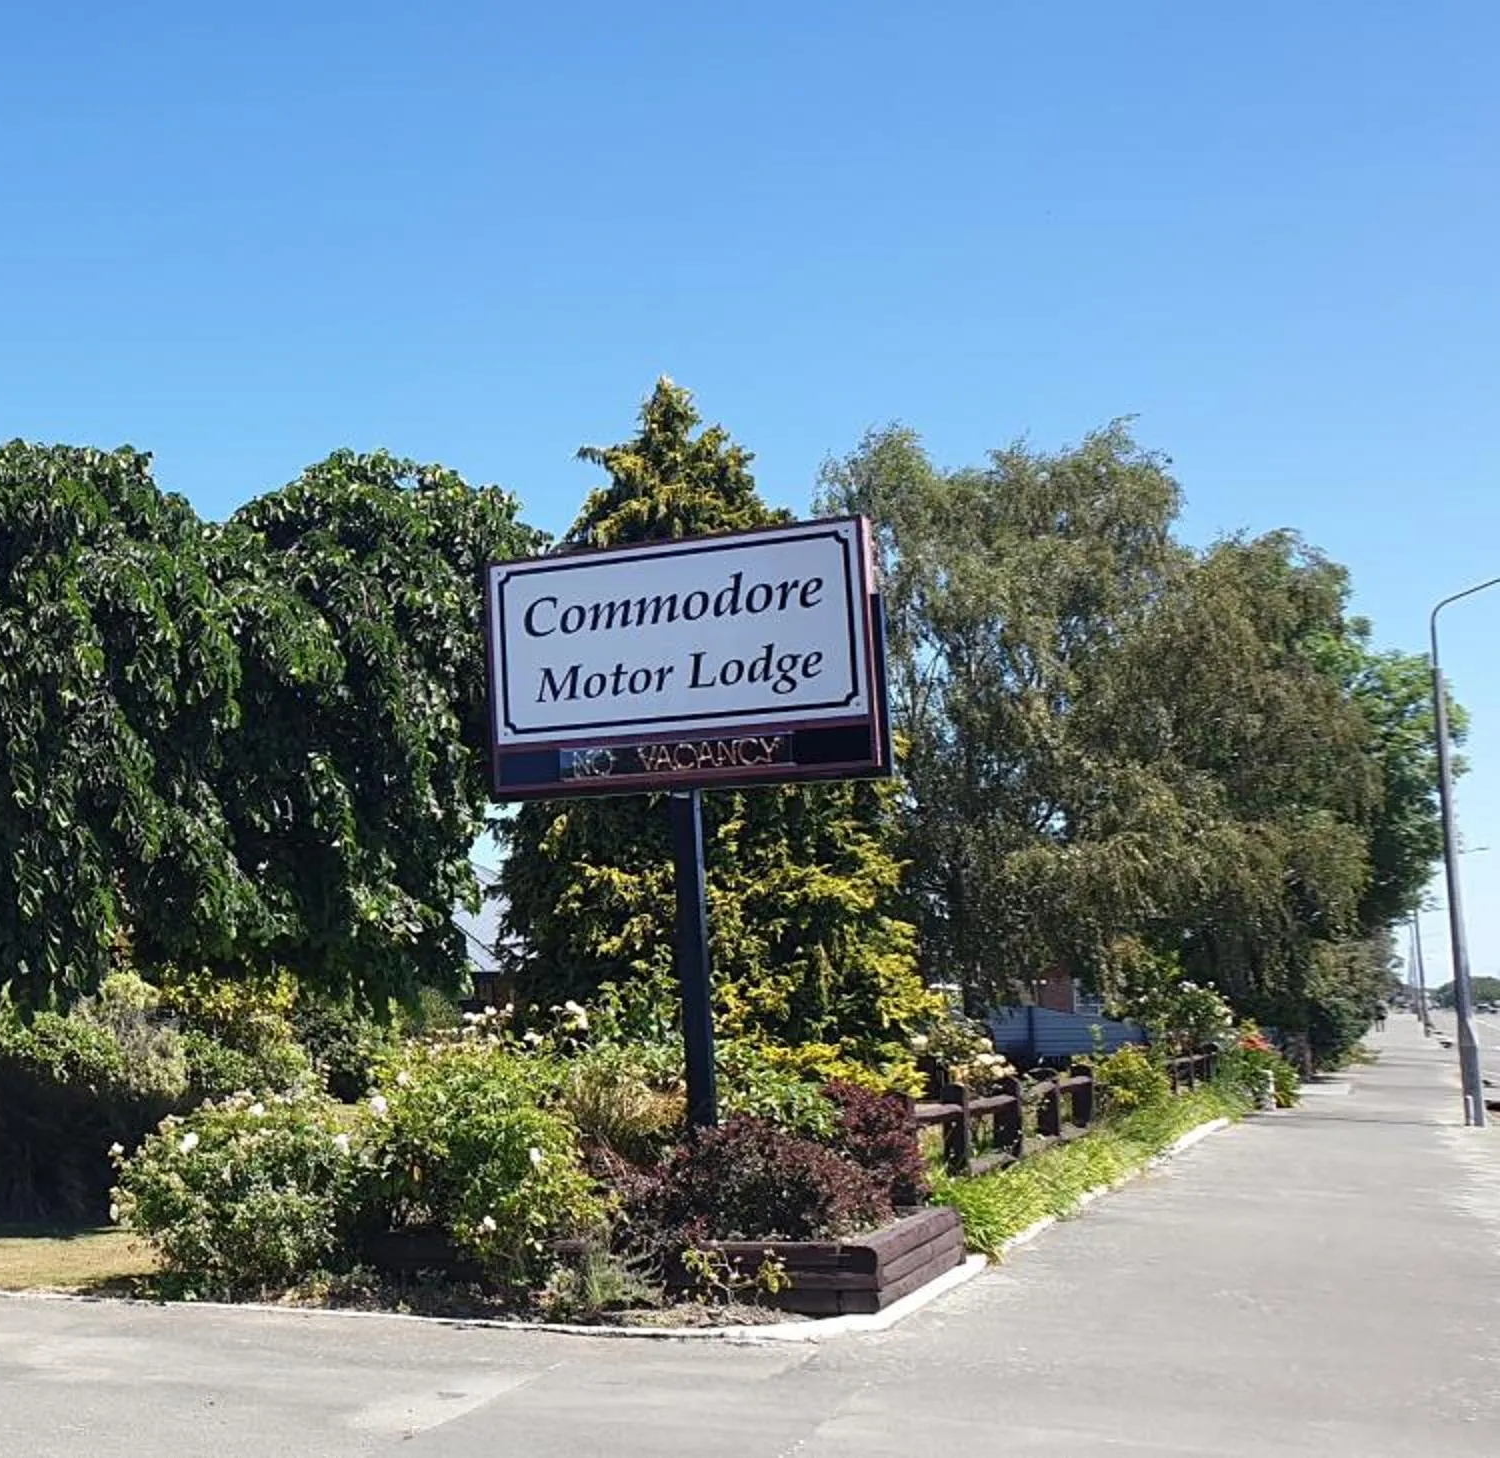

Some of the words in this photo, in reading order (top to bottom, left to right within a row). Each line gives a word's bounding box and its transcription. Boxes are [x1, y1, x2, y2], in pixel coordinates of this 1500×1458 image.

[523, 571, 824, 638] Commodore
[535, 661, 675, 703] Motor
[688, 643, 824, 695] Lodge
[572, 748, 616, 778] NO
[637, 735, 781, 772] VACANCY
